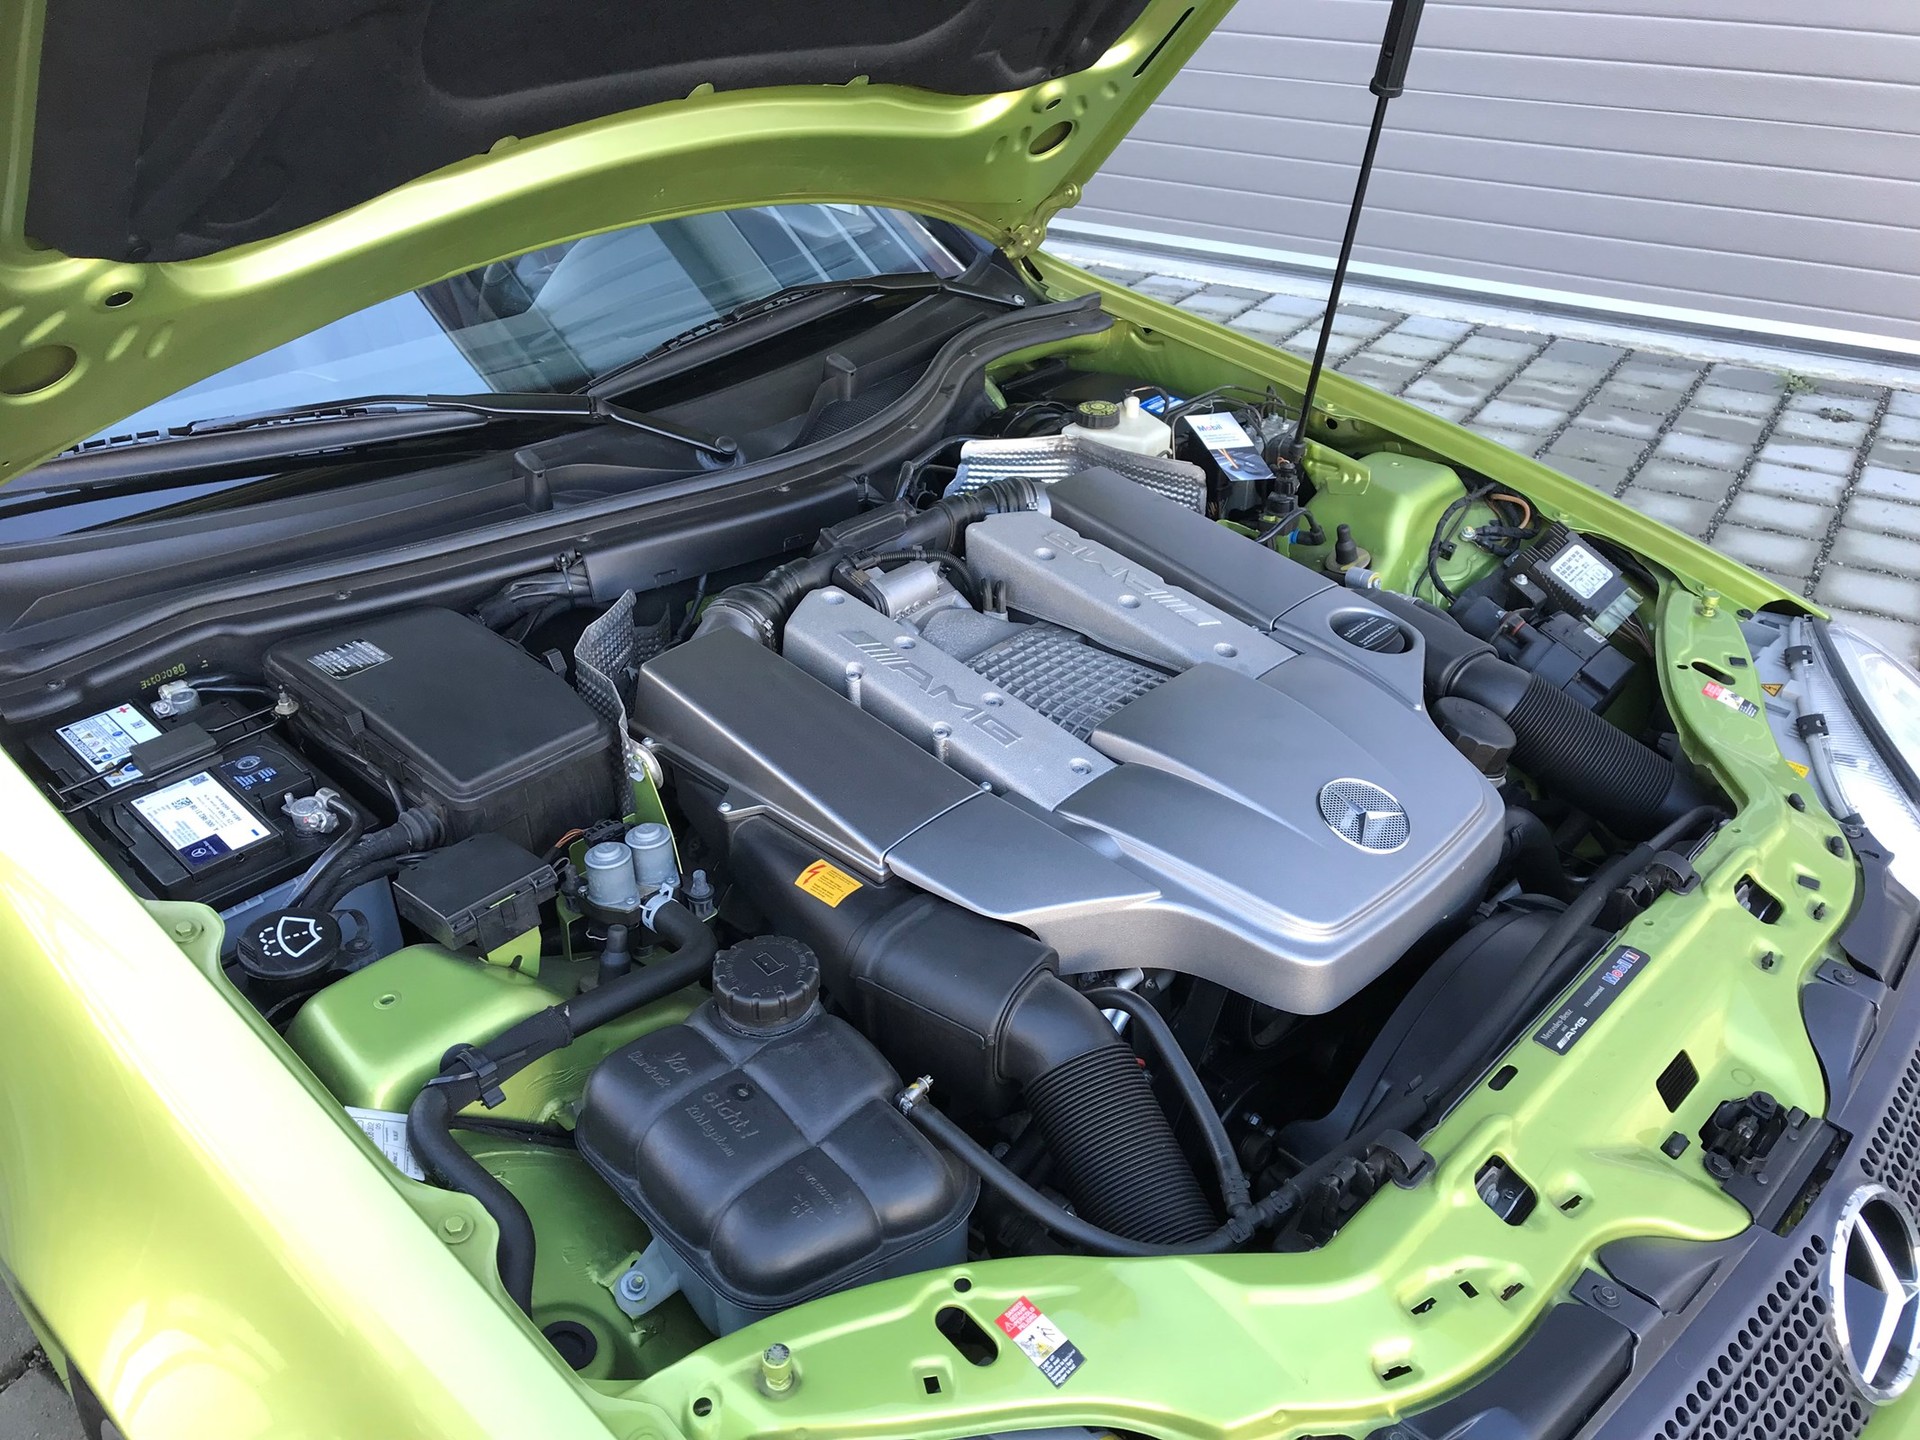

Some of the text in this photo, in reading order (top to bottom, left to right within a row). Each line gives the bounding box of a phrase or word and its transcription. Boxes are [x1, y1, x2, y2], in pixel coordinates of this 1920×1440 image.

[1043, 532, 1153, 596] AMG
[888, 662, 1024, 748] AMG
[1602, 958, 1633, 986] Mobil
[1540, 1008, 1573, 1041] Mercedes-Benz
